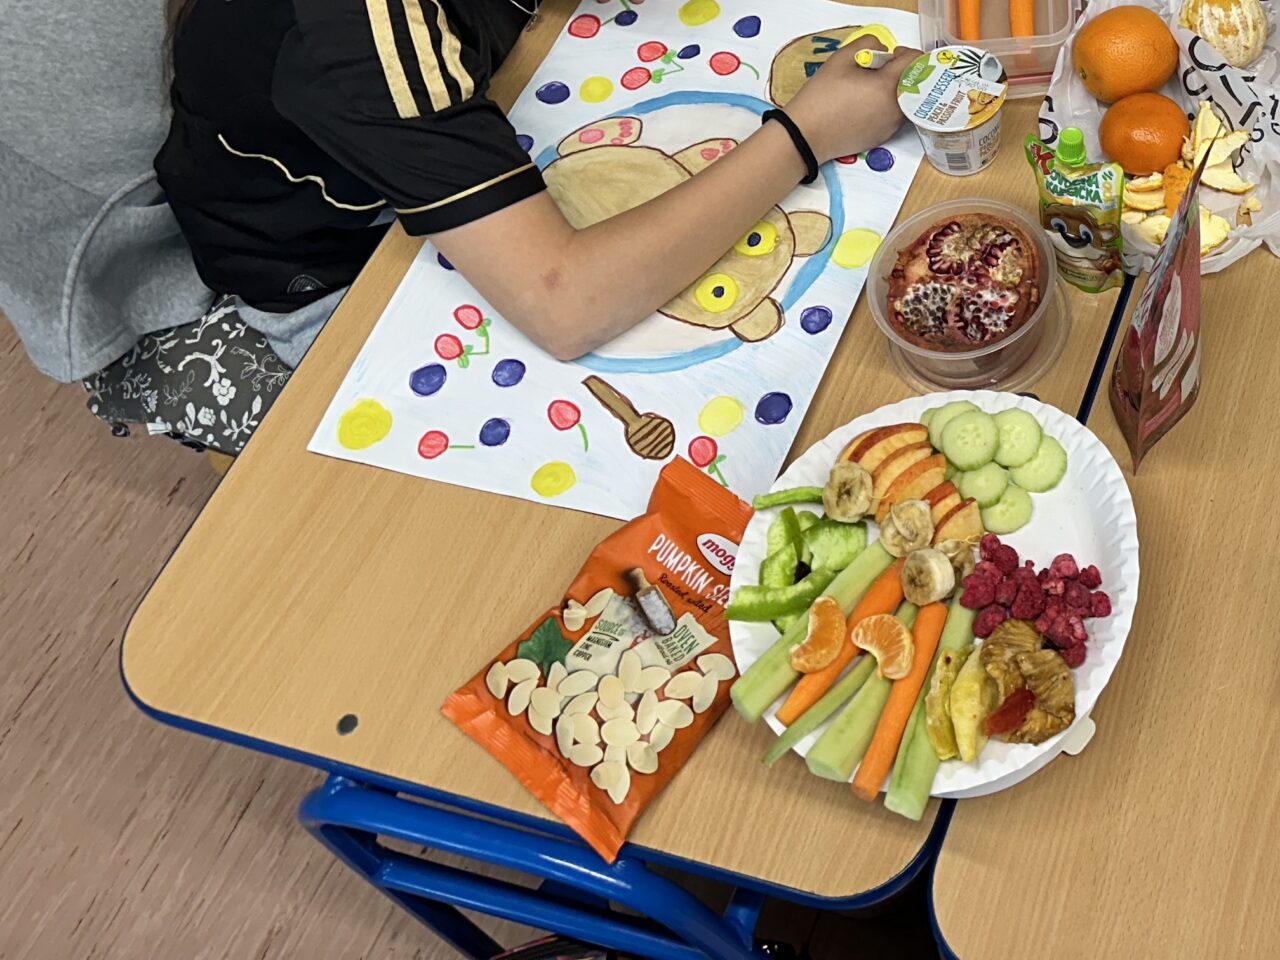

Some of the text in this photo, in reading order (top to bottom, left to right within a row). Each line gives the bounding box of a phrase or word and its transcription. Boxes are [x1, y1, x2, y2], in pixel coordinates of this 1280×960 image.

[914, 91, 938, 119] COCONUT
[931, 69, 957, 96] DESSERT
[936, 104, 957, 126] PASSION
[953, 91, 967, 109] FRUIT
[927, 102, 945, 123] PEACH
[648, 533, 714, 594] PUMPKIN
[594, 619, 623, 637] SOURCE
[673, 624, 700, 656] OVEN
[572, 650, 593, 662] COPPER
[661, 637, 687, 663] BAKED
